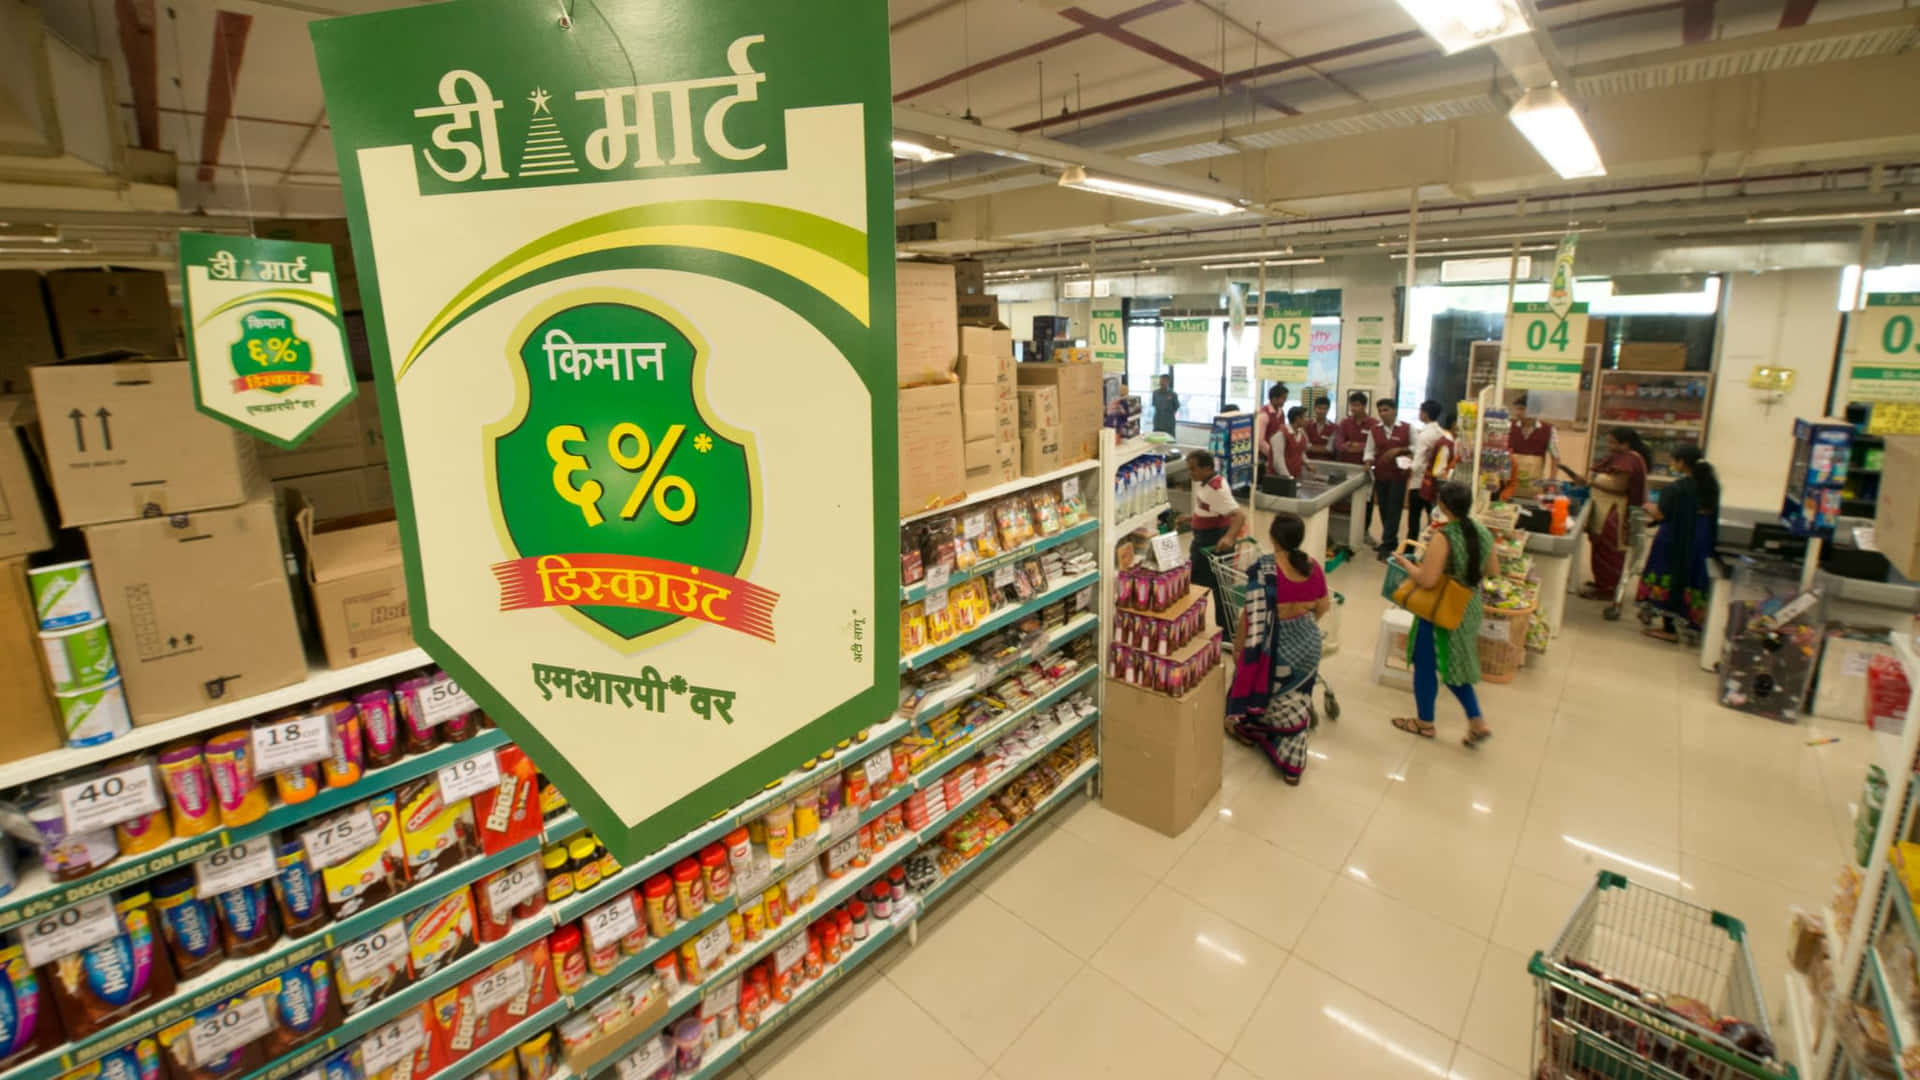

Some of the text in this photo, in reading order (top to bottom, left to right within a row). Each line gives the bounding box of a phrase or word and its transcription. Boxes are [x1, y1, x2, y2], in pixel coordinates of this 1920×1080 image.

[413, 34, 768, 184] डी मार्ट
[1099, 323, 1117, 345] 06
[1273, 323, 1301, 350] 05
[1525, 319, 1570, 352] 04
[1882, 314, 1920, 355] 0
[541, 328, 668, 383] किमान
[535, 554, 732, 622] डिस्काउंट
[266, 724, 302, 747] 18
[449, 759, 478, 782] 19
[76, 776, 124, 803] 40
[317, 820, 354, 846] 75
[209, 844, 248, 867] 60
[36, 907, 81, 936] 60
[597, 905, 620, 929] 25
[352, 933, 388, 961] 30
[202, 1010, 242, 1039] 30
